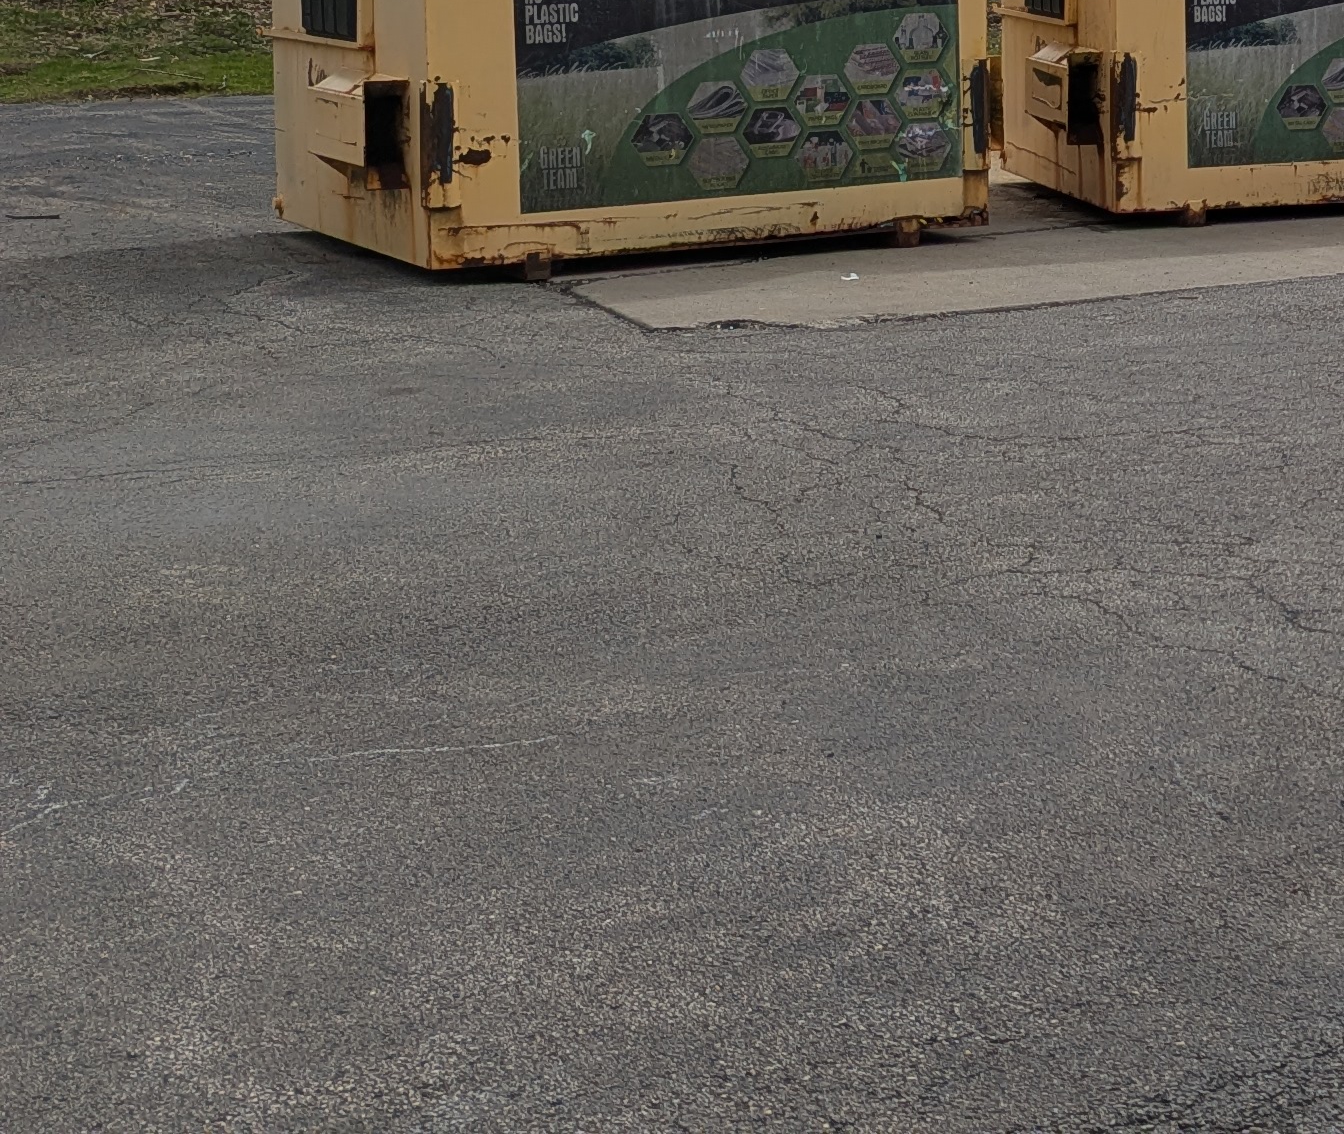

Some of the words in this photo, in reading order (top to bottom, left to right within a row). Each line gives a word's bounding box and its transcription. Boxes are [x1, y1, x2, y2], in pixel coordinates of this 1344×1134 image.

[524, 2, 579, 24] PLASTIC
[1193, 5, 1227, 23] BAGS!
[525, 24, 567, 44] BAGS!
[1203, 111, 1236, 130] GREEN
[1205, 130, 1234, 148] TEAM
[539, 146, 581, 169] GREEN
[543, 168, 578, 190] TEAM
